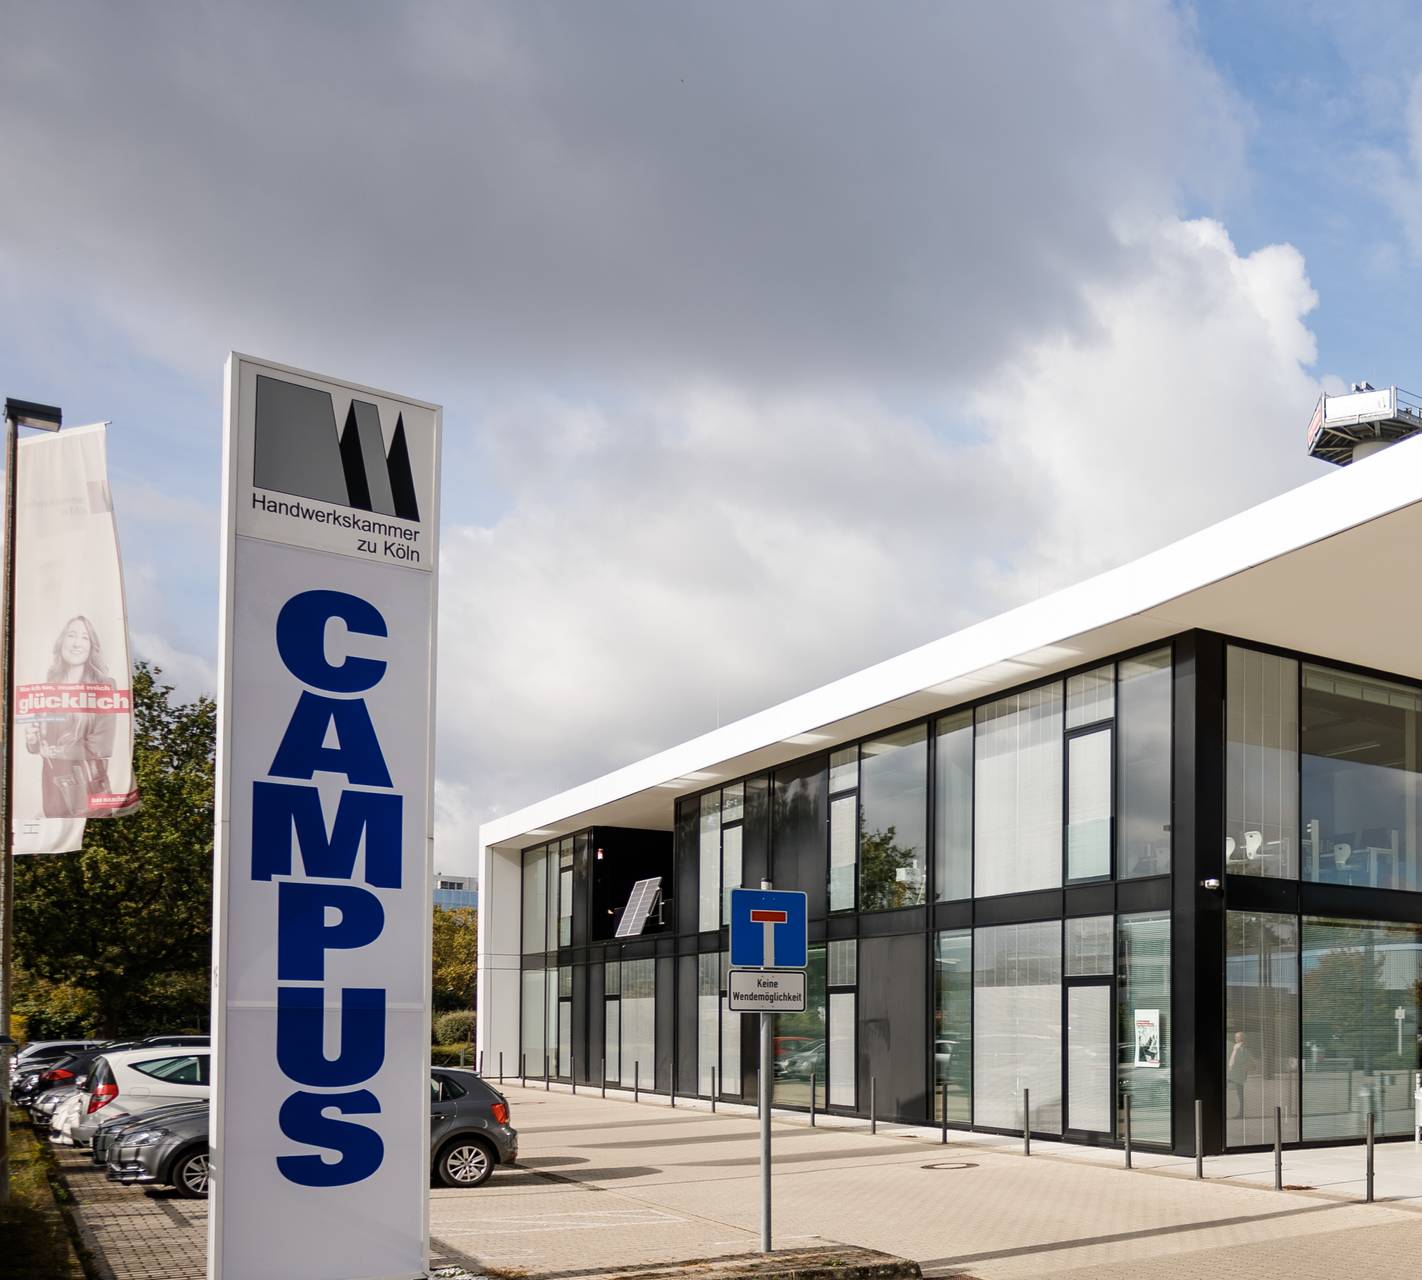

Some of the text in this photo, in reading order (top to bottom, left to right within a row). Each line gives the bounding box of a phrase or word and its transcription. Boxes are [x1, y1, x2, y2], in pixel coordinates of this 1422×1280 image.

[252, 493, 420, 541] Handwerkskammer
[357, 539, 420, 562] zu Köln
[19, 692, 129, 714] glücklich
[251, 589, 403, 1187] CAMPUS
[756, 978, 779, 989] Keine
[732, 991, 802, 1004] Wendemöglichkeit
